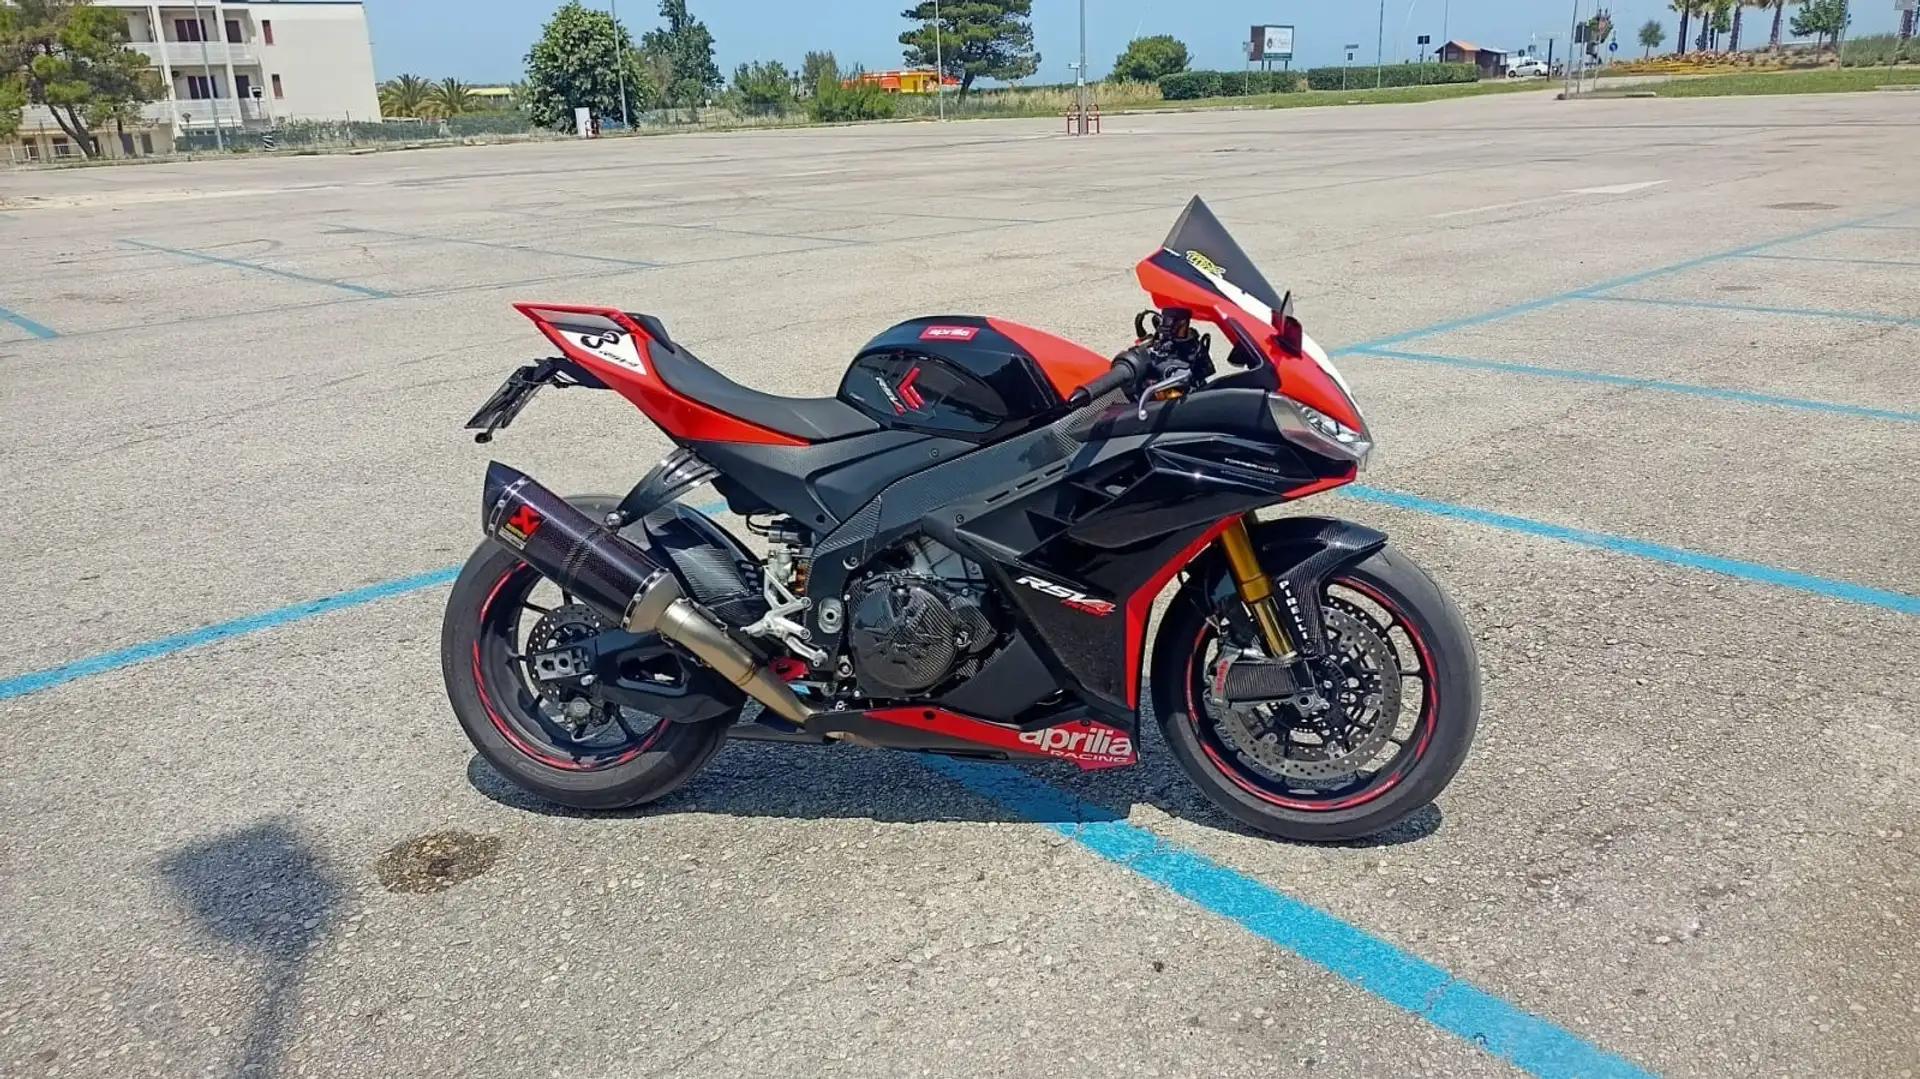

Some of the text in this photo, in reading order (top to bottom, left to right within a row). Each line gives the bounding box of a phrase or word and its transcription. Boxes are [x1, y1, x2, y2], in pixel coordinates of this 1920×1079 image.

[927, 328, 971, 337] aprilia
[1279, 580, 1308, 640] PIRELLI
[1019, 727, 1133, 756] aprilia
[1050, 750, 1130, 763] RACING
